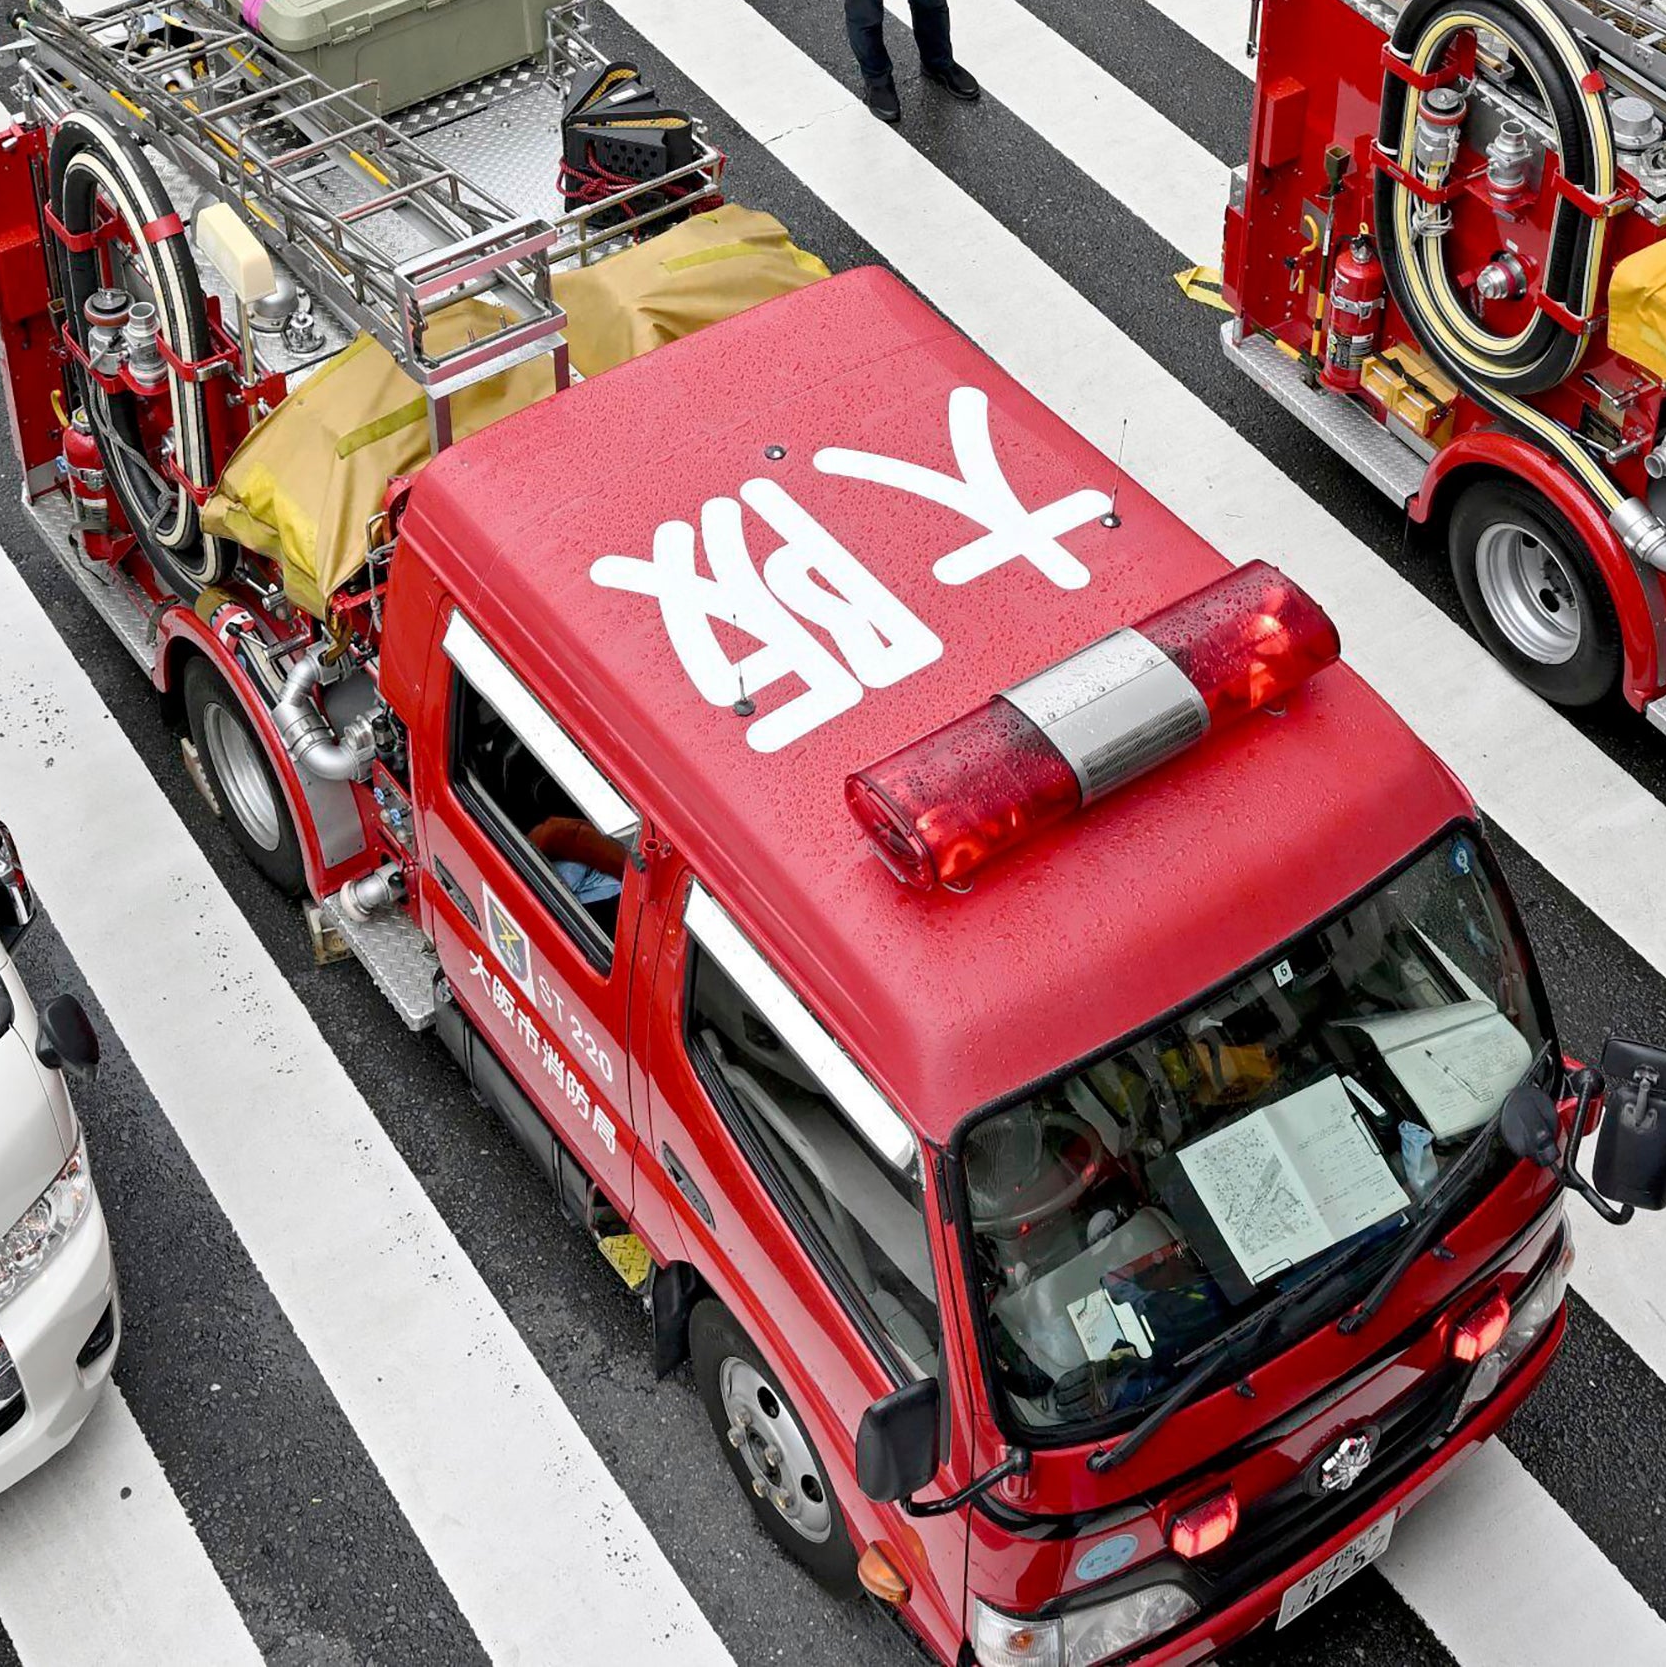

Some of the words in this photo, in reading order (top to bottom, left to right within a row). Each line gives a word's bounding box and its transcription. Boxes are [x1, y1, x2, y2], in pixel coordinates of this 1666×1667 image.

[590, 386, 1116, 754] 大阪
[538, 975, 564, 1023] ST
[570, 1014, 613, 1083] 220
[1280, 963, 1289, 977] 6
[469, 948, 616, 1155] 大阪市消防局
